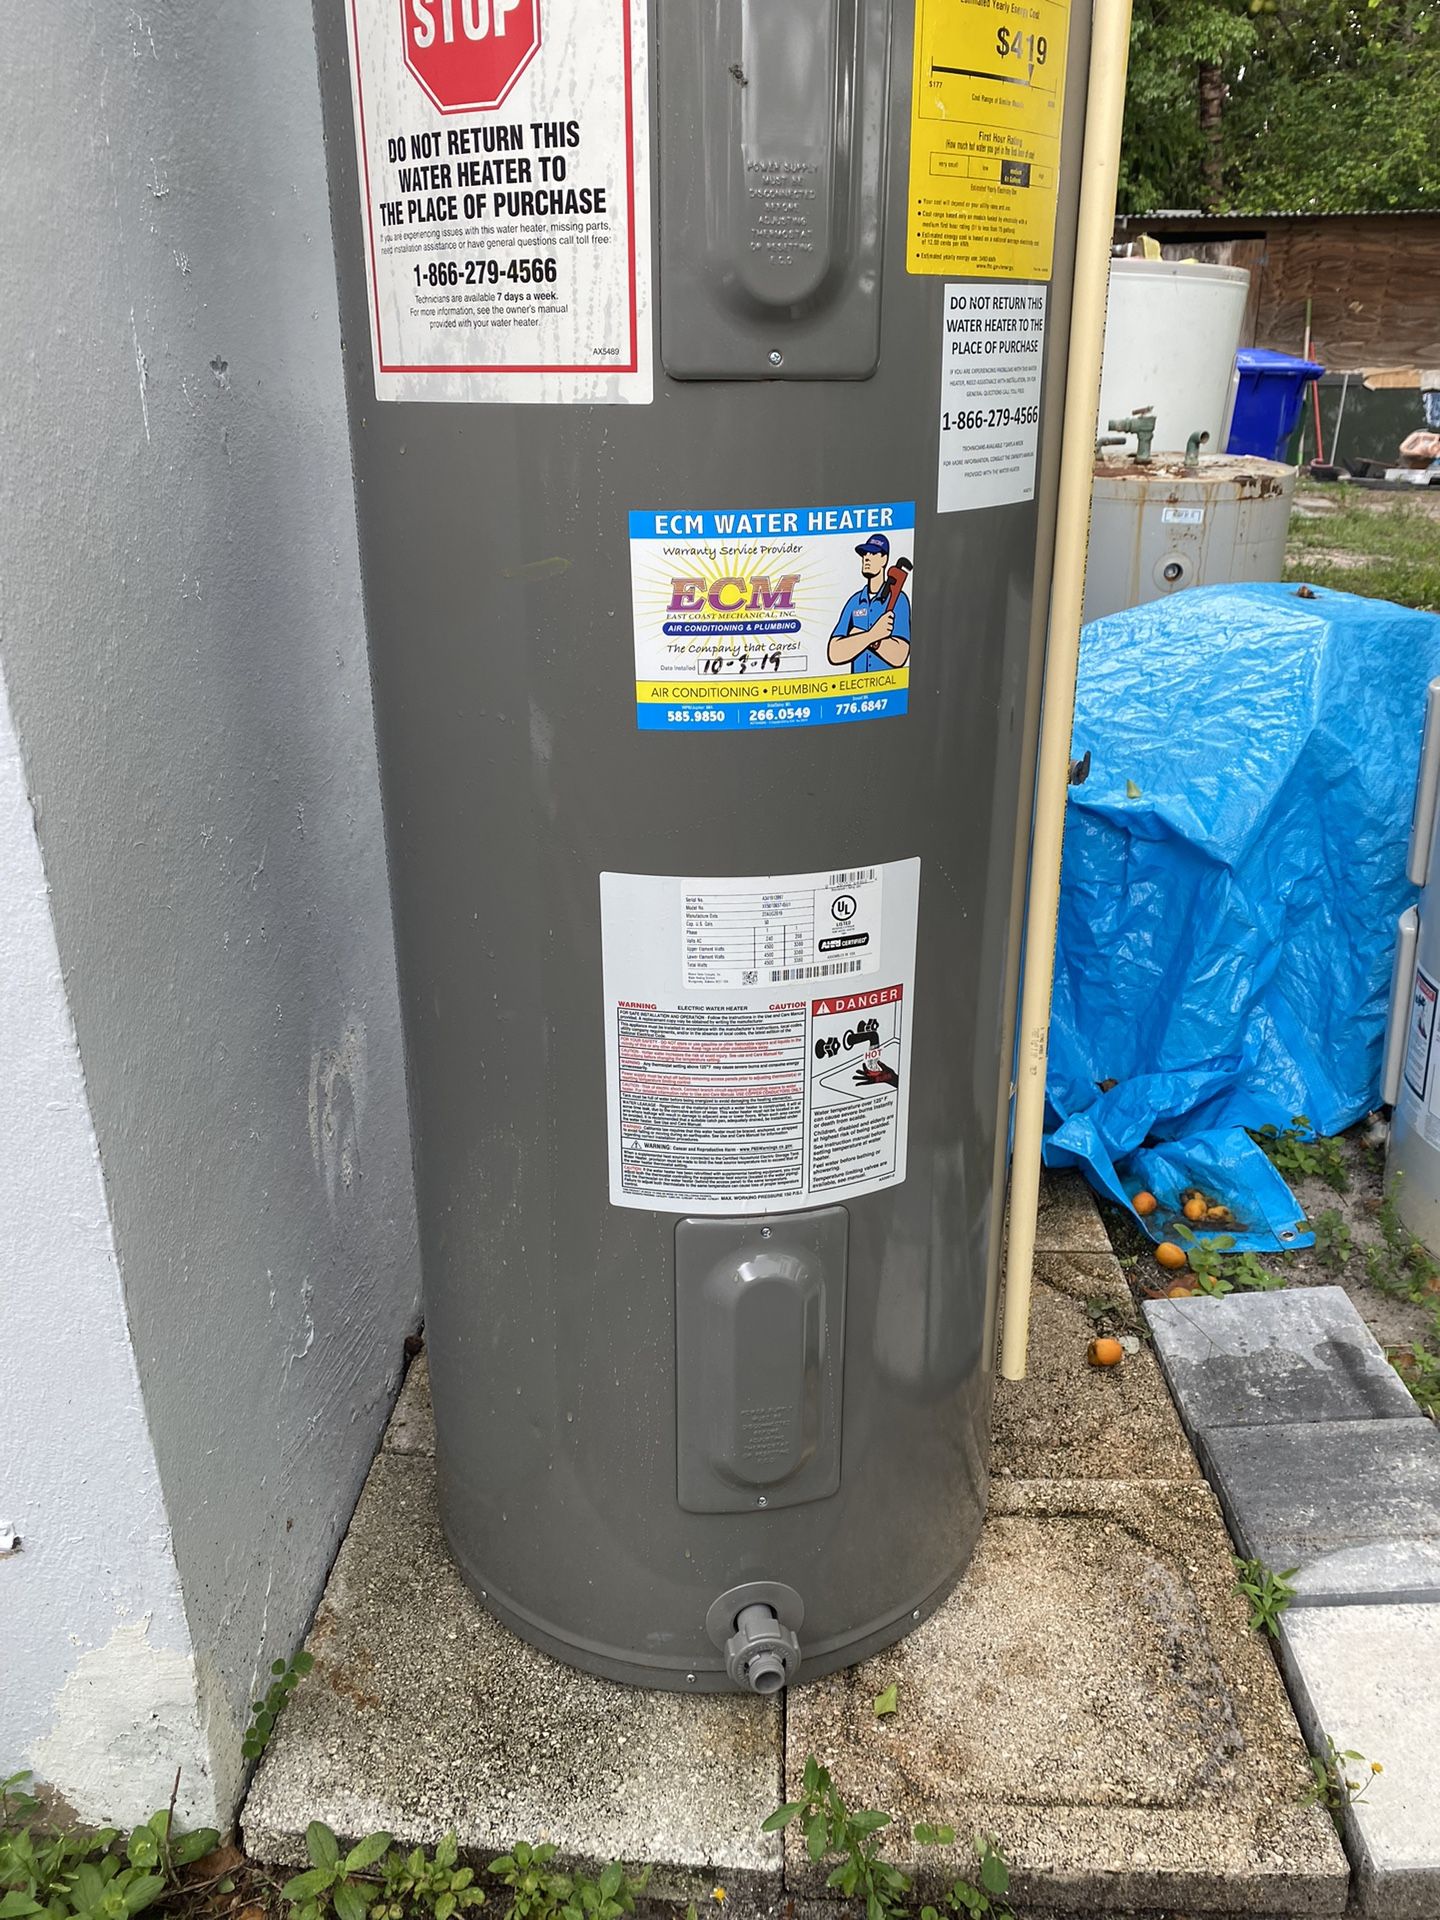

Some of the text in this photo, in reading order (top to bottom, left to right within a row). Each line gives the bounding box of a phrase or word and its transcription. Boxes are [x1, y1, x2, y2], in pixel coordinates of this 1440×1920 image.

[993, 0, 1010, 14] Yearly
[996, 26, 1047, 65] $419
[929, 81, 943, 90] $177
[388, 120, 580, 163] DO NOT RETURN THIS
[979, 131, 992, 142] First
[993, 133, 1006, 144] Hour
[399, 155, 566, 193] WATER HEATER TO
[380, 188, 607, 226] THE PLACE OF PURCHASE
[403, 229, 440, 240] experiencing
[442, 228, 463, 237] issues
[464, 226, 479, 235] with
[481, 225, 495, 234] this
[496, 225, 518, 234] water
[519, 223, 549, 233] heater,
[551, 222, 584, 233] missing
[586, 221, 611, 232] parts,
[423, 241, 457, 251] assistance
[458, 241, 466, 249] or
[467, 239, 485, 249] have
[486, 237, 515, 250] general
[517, 236, 557, 248] questions
[559, 235, 574, 244] call
[576, 235, 589, 244] toll
[591, 234, 612, 243] free:
[413, 257, 558, 287] 1-866-279-4566
[415, 294, 450, 304] Technicians
[451, 295, 462, 303] are
[464, 293, 495, 302] available
[497, 292, 502, 301] 7
[504, 292, 524, 303] days
[533, 291, 559, 301] week.
[950, 296, 1043, 310] DO NOT RETURN THIS
[410, 304, 568, 317] For more information, see the owner's manual
[429, 317, 541, 330] provided with your water heater.
[947, 318, 1043, 333] WATER HEATER TO THE
[593, 347, 620, 357] AX5489
[952, 340, 1039, 355] PLACE OF PURCHASE
[942, 406, 1038, 431] 1-866-279-4566
[655, 507, 893, 535] ECM WATER HEATER
[663, 543, 803, 560] Warranty Service Provider
[666, 574, 801, 612] ECM
[717, 612, 777, 620] MECHANICAL,
[779, 611, 796, 619] INC.
[668, 621, 796, 632] AIR CONDITIONING & PLUMBING
[667, 641, 801, 657] The Company that Cares!
[651, 675, 896, 698] AIR CONDITIONING PLUMBING ELECTRICAL
[750, 707, 811, 722] 266.0549
[835, 698, 888, 716] 776.6847
[667, 710, 725, 722] 585.9850
[838, 901, 850, 915] UL
[618, 1001, 656, 1009] WARNING
[769, 1001, 806, 1010] CAUTION
[836, 988, 898, 1011] DANGER
[865, 1049, 882, 1060] HOT
[644, 1142, 672, 1150] WARNING:
